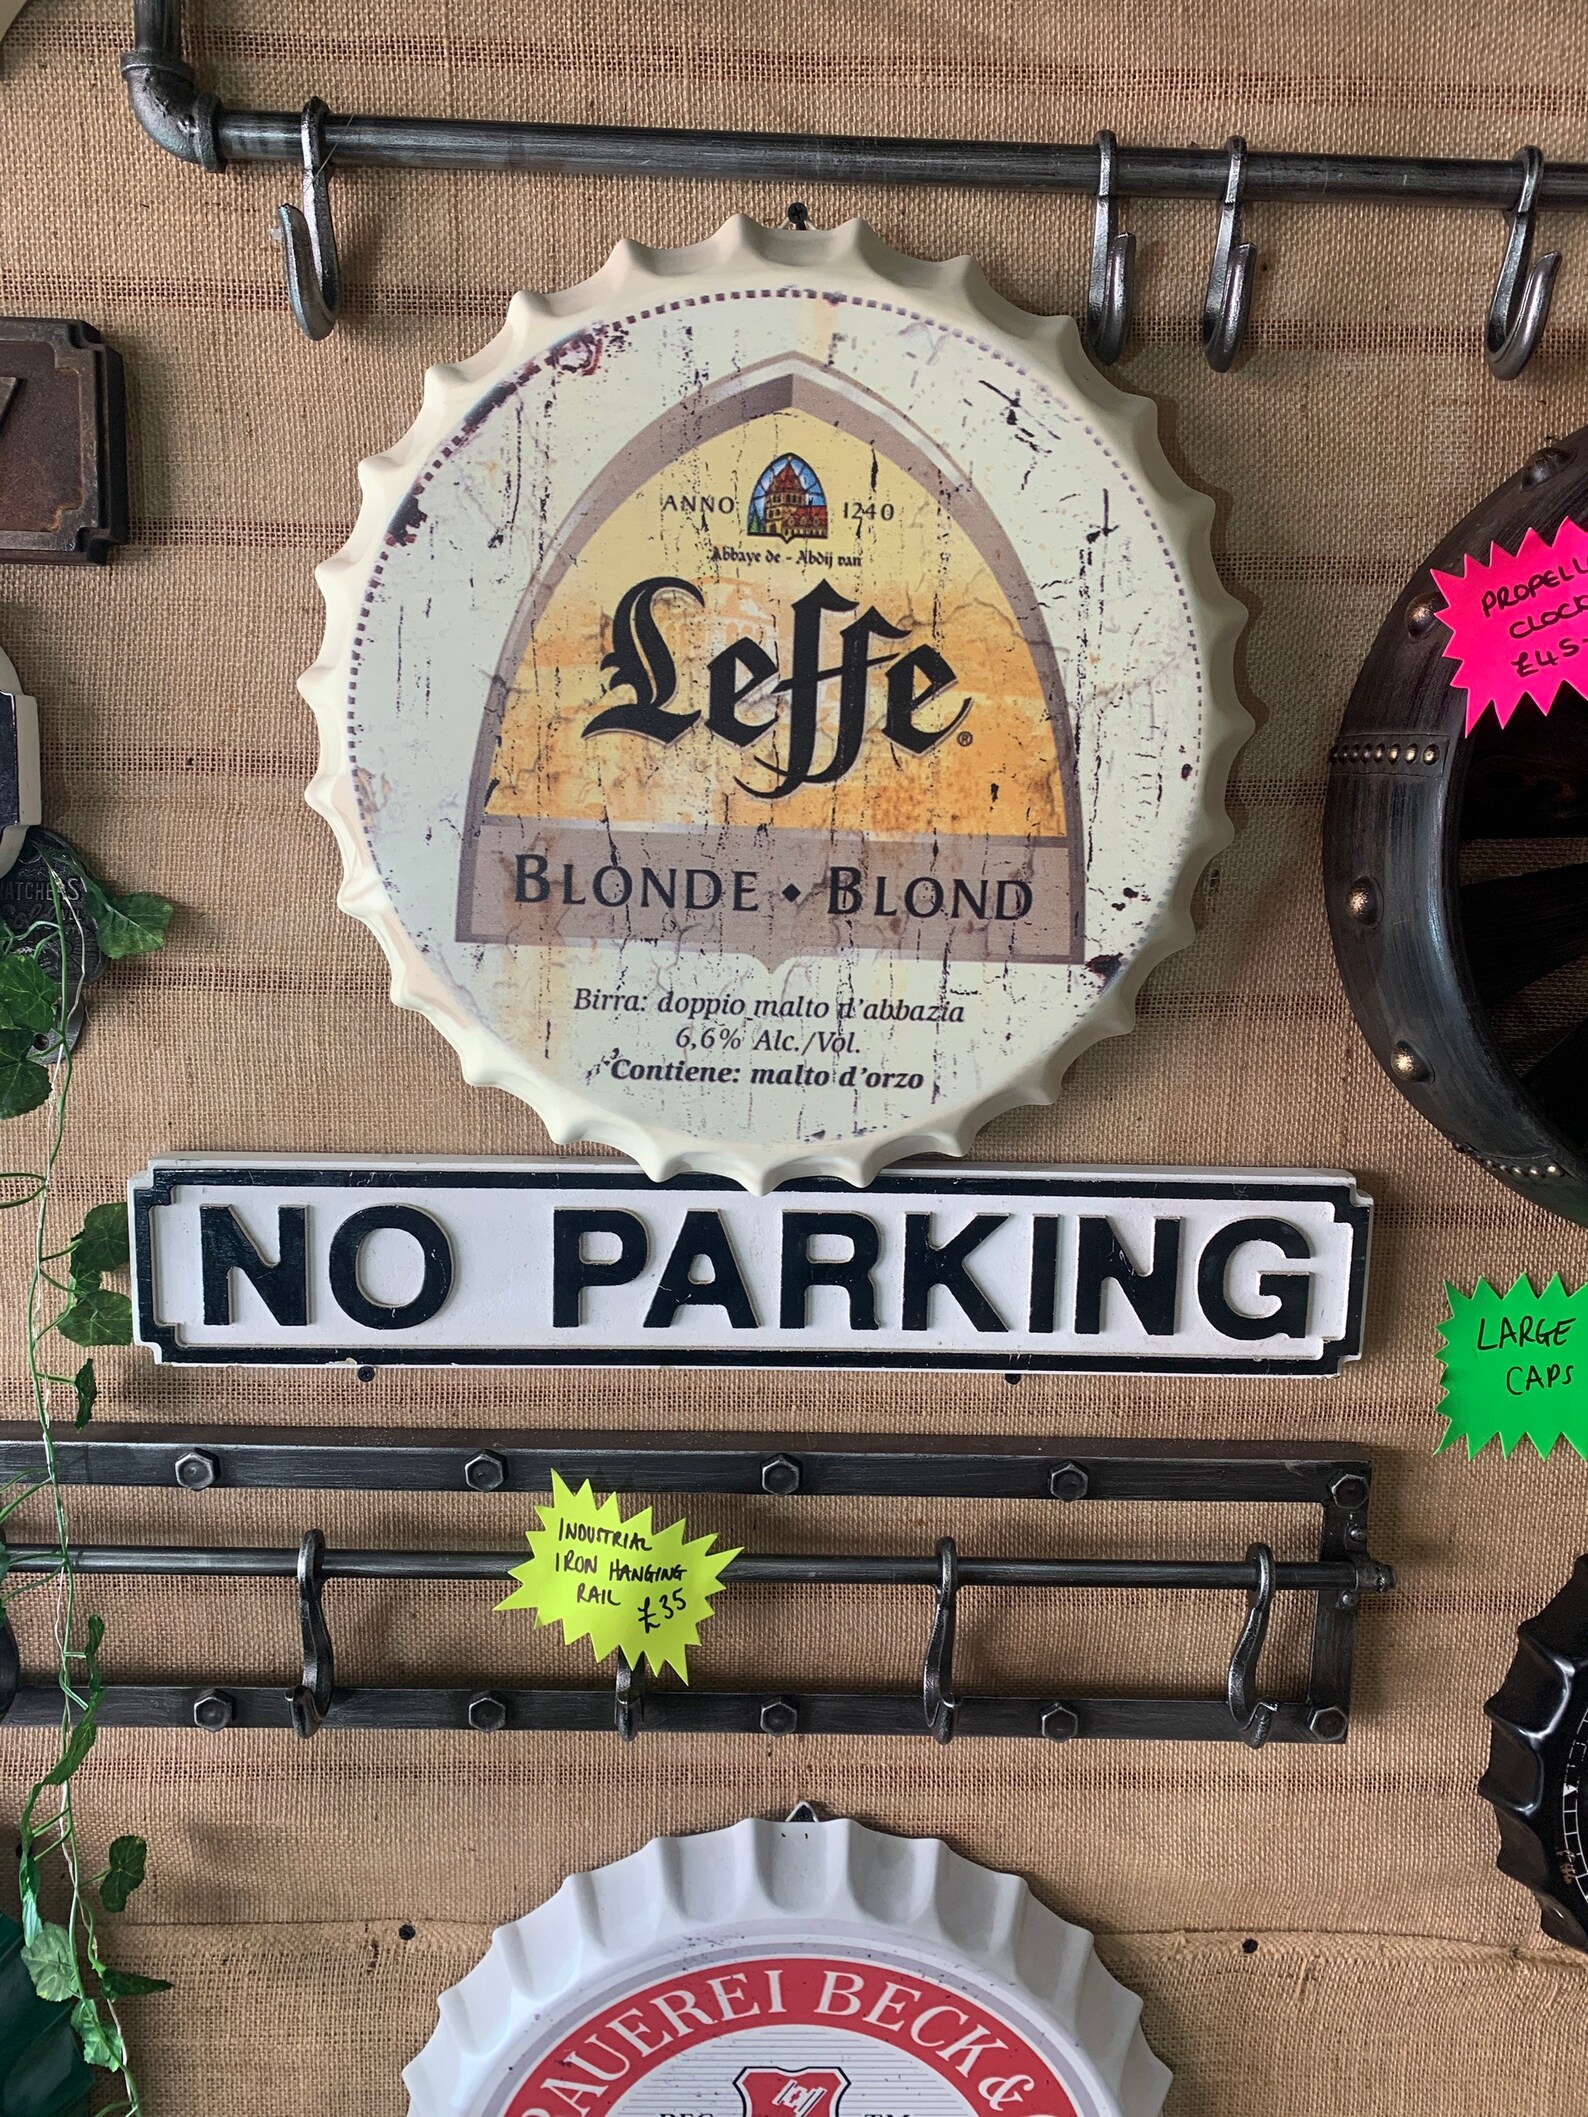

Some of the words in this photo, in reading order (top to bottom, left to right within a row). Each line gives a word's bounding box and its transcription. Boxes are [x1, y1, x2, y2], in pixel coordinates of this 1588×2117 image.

[661, 494, 735, 514] ANNO
[842, 502, 895, 521] 1240
[711, 546, 761, 568] Abbaye
[765, 550, 781, 564] de
[796, 550, 833, 569] Abdij
[837, 554, 863, 568] van
[1481, 556, 1588, 619] PROPELL
[581, 576, 972, 801] Leffe
[514, 854, 758, 912] BLONDE
[827, 866, 1033, 921] BLOND
[574, 987, 648, 1012] Birra:
[657, 990, 746, 1020] doppio
[753, 996, 830, 1018] malto
[837, 998, 965, 1023] d'abbazia
[675, 1026, 742, 1051] 6,6%
[752, 1029, 861, 1056] Alc./Vol.
[611, 1059, 741, 1083] Contiene:
[750, 1064, 830, 1087] malto
[838, 1066, 924, 1090] d'orzo
[200, 1203, 455, 1330] NO
[553, 1205, 1312, 1341] PARKING
[1476, 1315, 1577, 1351] LARGE
[1506, 1363, 1575, 1396] CAPS
[558, 1517, 653, 1551] INDUSTRIAL
[555, 1549, 598, 1574] IRON
[609, 1558, 688, 1583] HANGING
[576, 1582, 621, 1606] RAIL
[637, 1587, 687, 1634] £35
[521, 1969, 788, 2117] AUEREI
[813, 1970, 1009, 2078] BECK
[977, 2074, 1036, 2112] &
